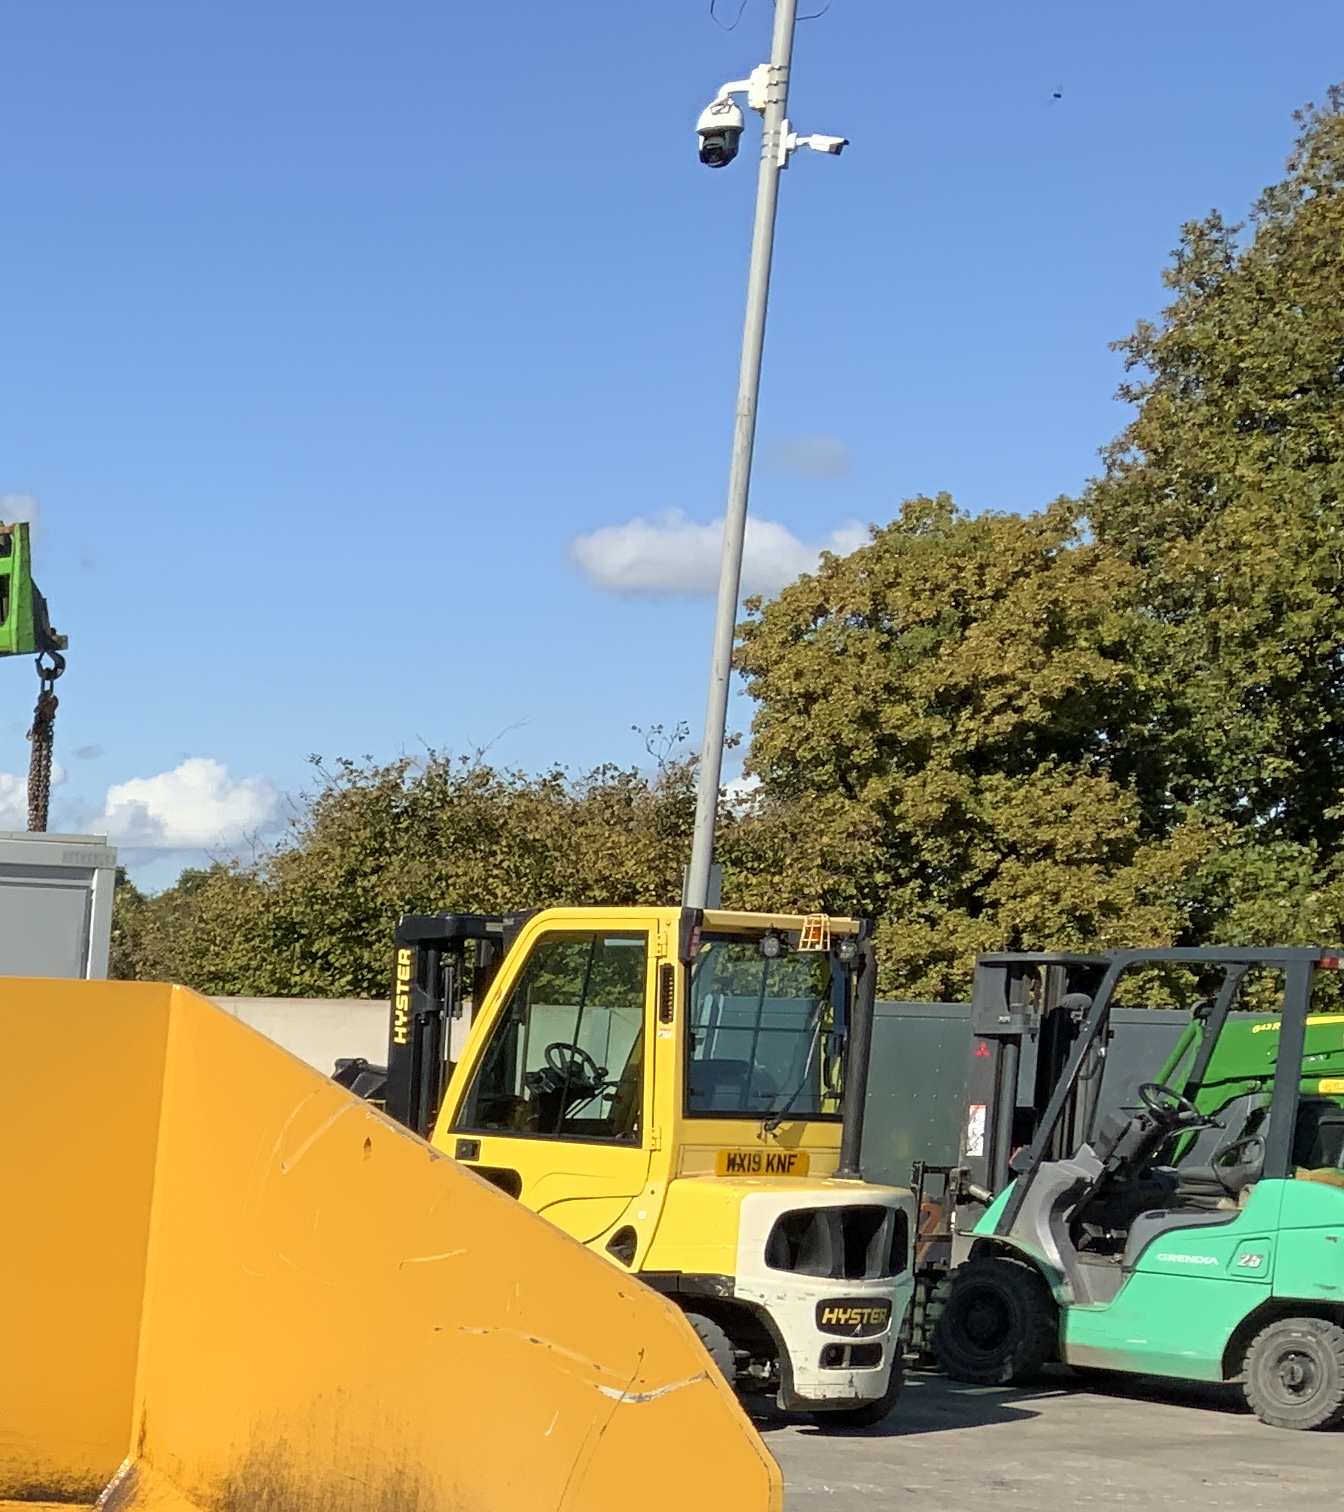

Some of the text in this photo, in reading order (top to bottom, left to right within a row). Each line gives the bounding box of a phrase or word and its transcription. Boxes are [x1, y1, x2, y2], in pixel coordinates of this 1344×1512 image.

[393, 948, 411, 1044] HYSTER
[726, 1152, 798, 1174] WX19 KNF
[1156, 1252, 1265, 1269] GRENDIA 25
[821, 1307, 888, 1325] HYSTER
